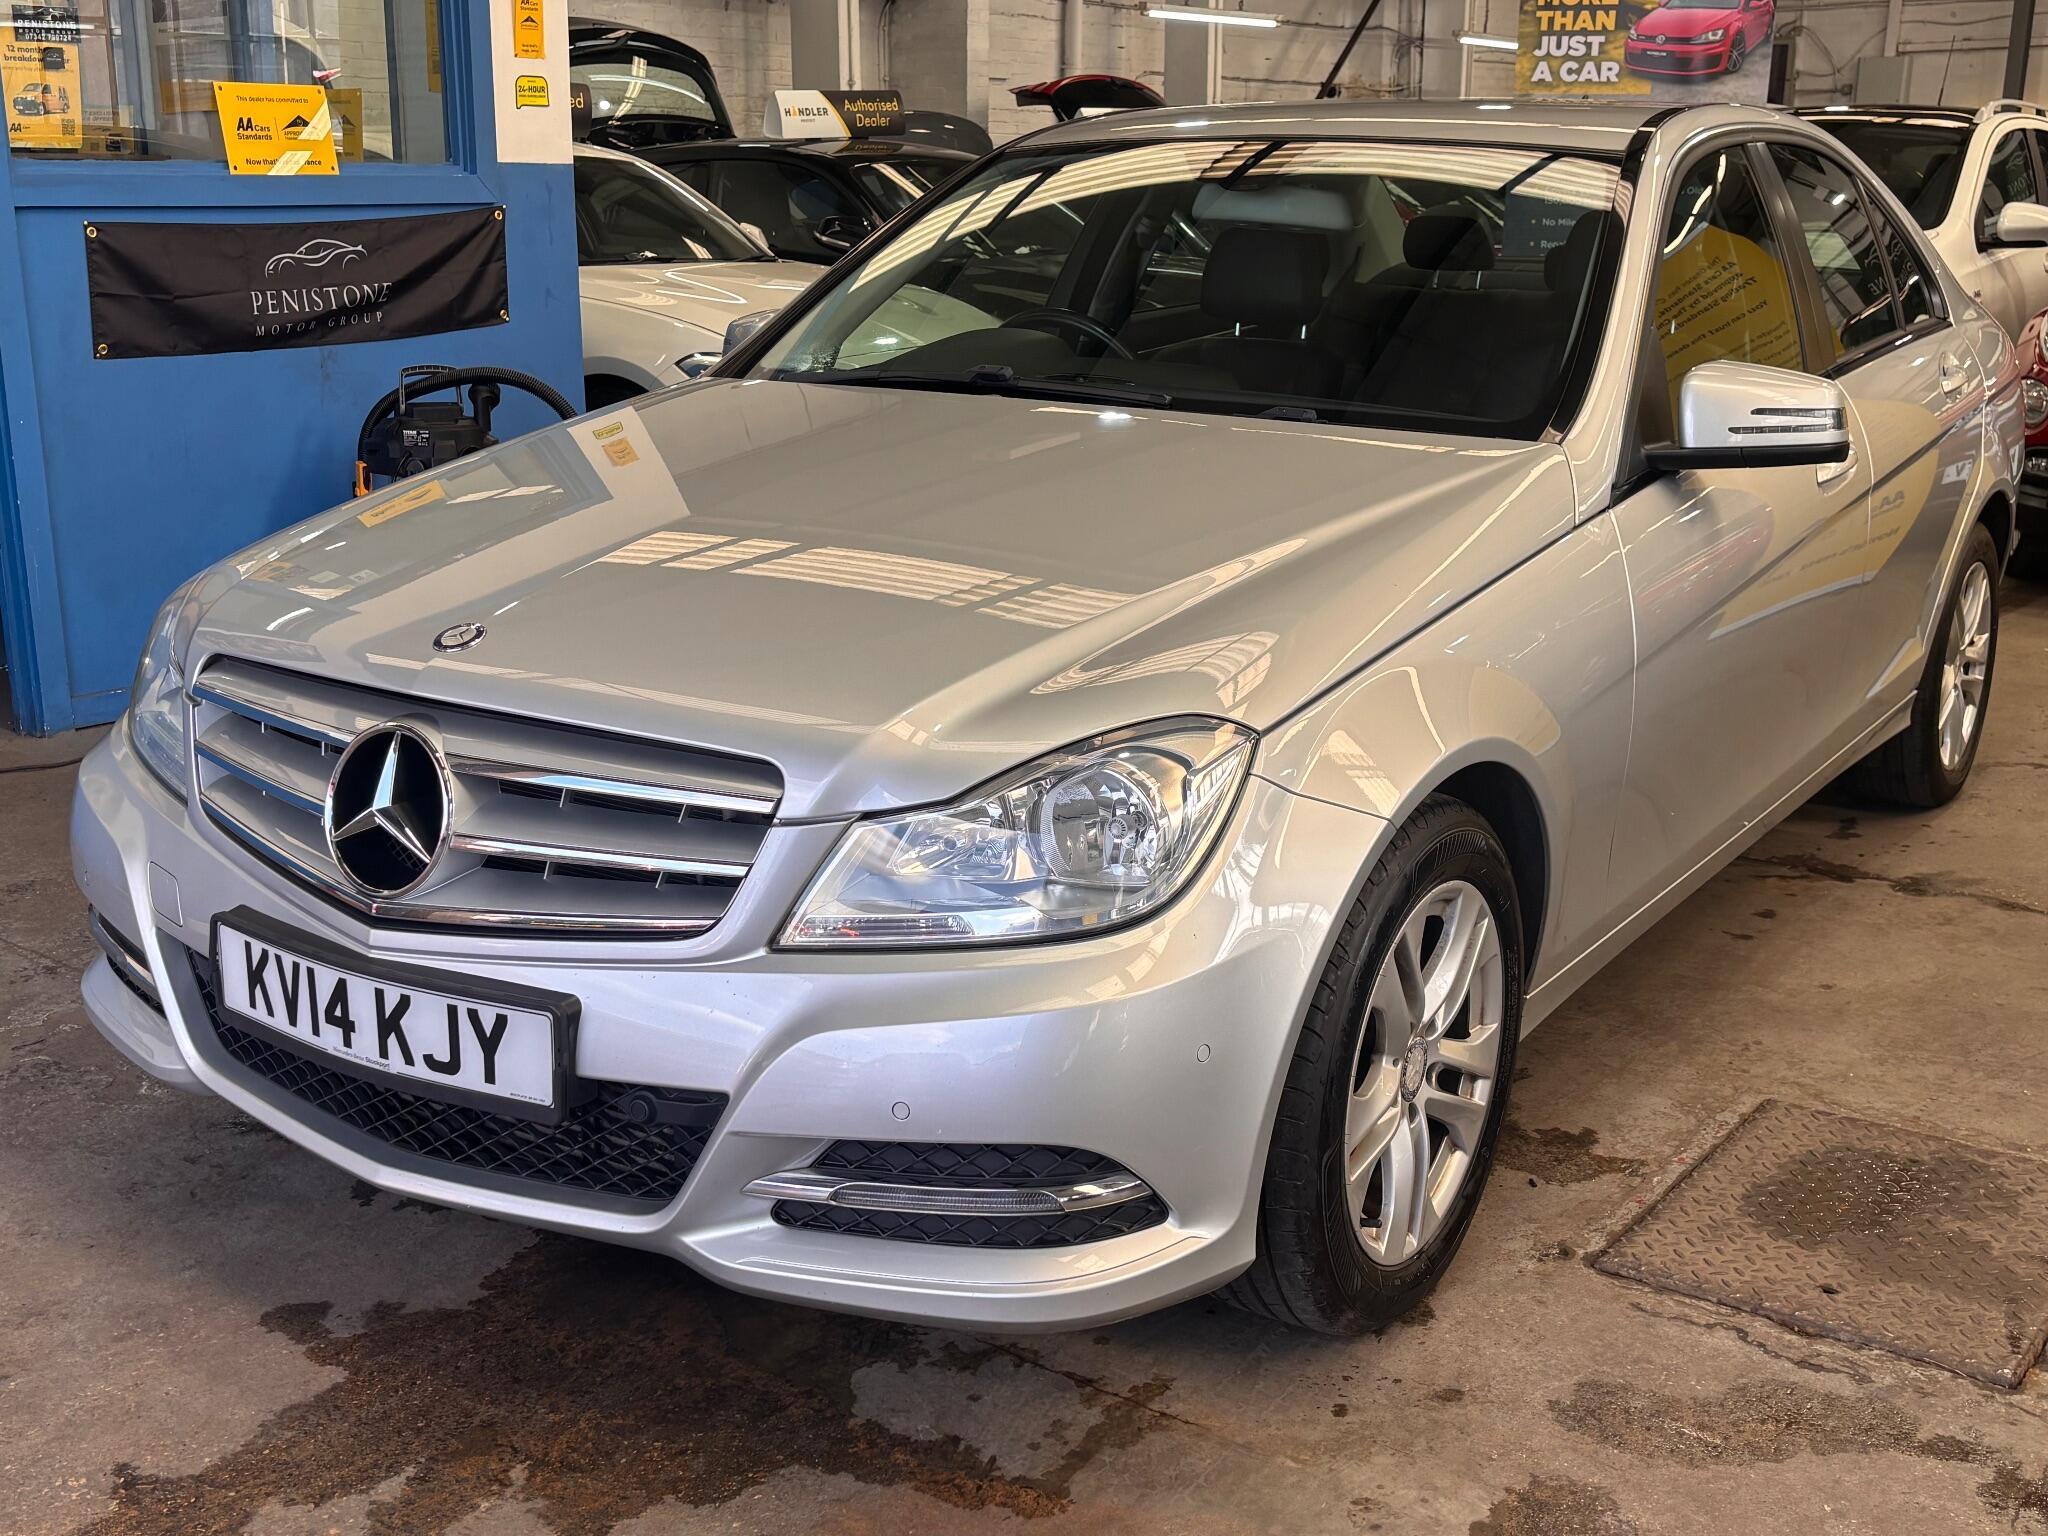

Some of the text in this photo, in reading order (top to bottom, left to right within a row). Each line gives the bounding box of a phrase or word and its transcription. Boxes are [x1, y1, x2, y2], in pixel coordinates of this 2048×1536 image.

[16, 20, 76, 29] PENISTONE
[1536, 10, 1616, 31] THAN
[1532, 35, 1606, 57] JUST
[1531, 60, 1620, 82] A CAR
[518, 85, 546, 93] 24-HOUR
[844, 98, 899, 112] Authorised
[237, 117, 271, 132] AA Cars
[856, 114, 891, 127] Dealer
[10, 123, 22, 132] AA
[237, 132, 272, 140] Standards
[246, 158, 262, 166] Now
[1542, 218, 1576, 226] No Mile
[250, 282, 392, 315] PENISTONE
[255, 311, 383, 337] MOTOR GROUP
[244, 939, 509, 1086] KV14 KJY
[365, 1056, 390, 1068] Stockport
